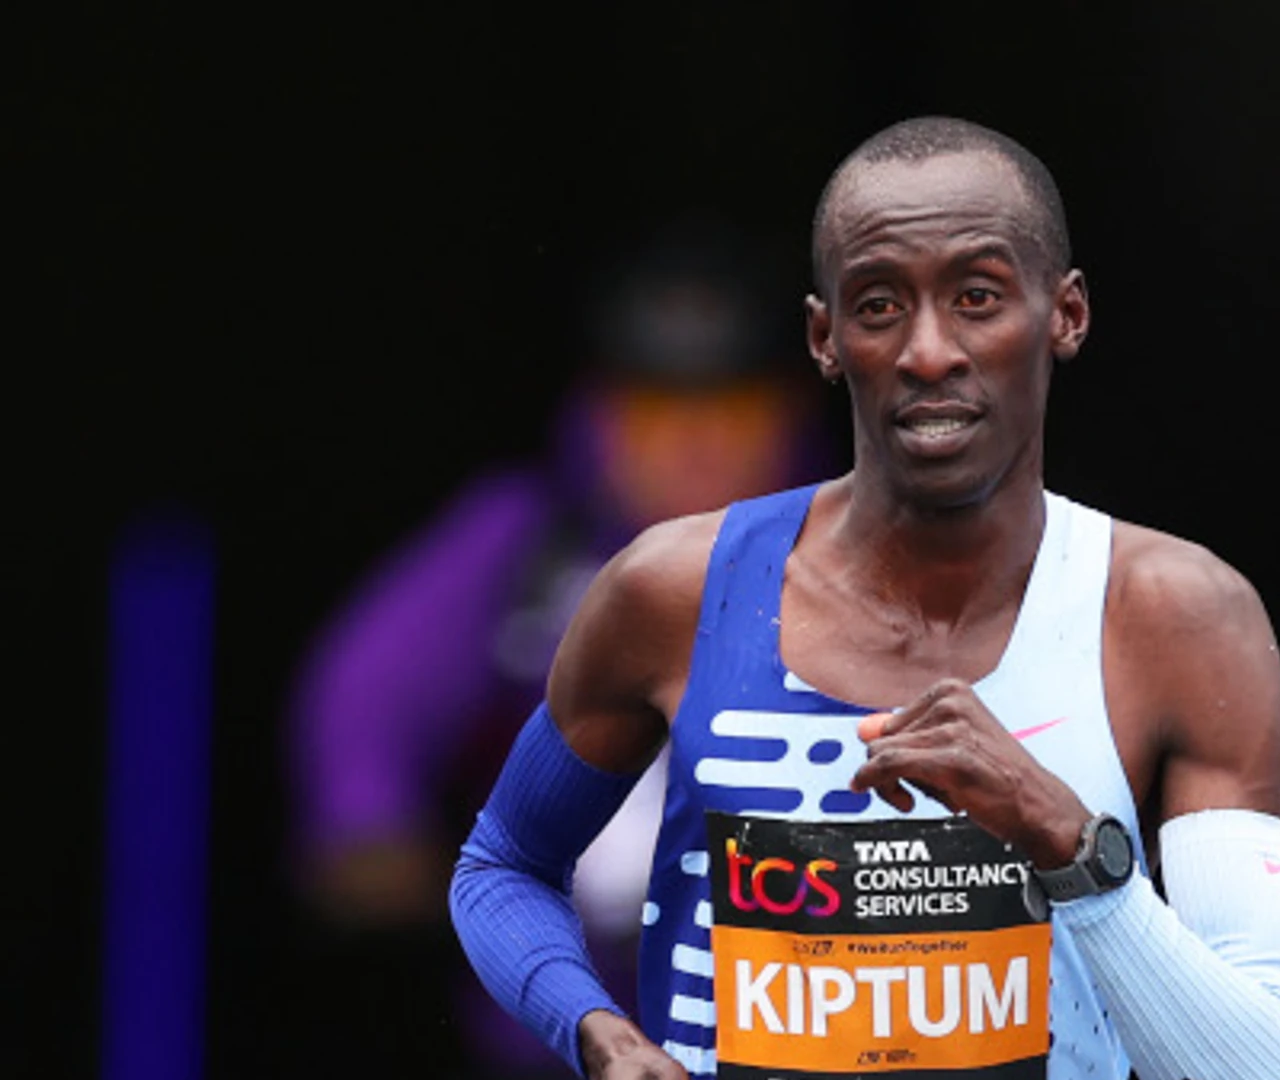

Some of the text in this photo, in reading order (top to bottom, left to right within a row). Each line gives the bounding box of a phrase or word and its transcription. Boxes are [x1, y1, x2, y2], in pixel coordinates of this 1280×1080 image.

[853, 841, 931, 863] TATA
[726, 838, 840, 917] tcs
[854, 863, 1031, 891] CONSULTANCY
[855, 892, 970, 919] SERVICES
[734, 956, 1029, 1038] KIPTUM
